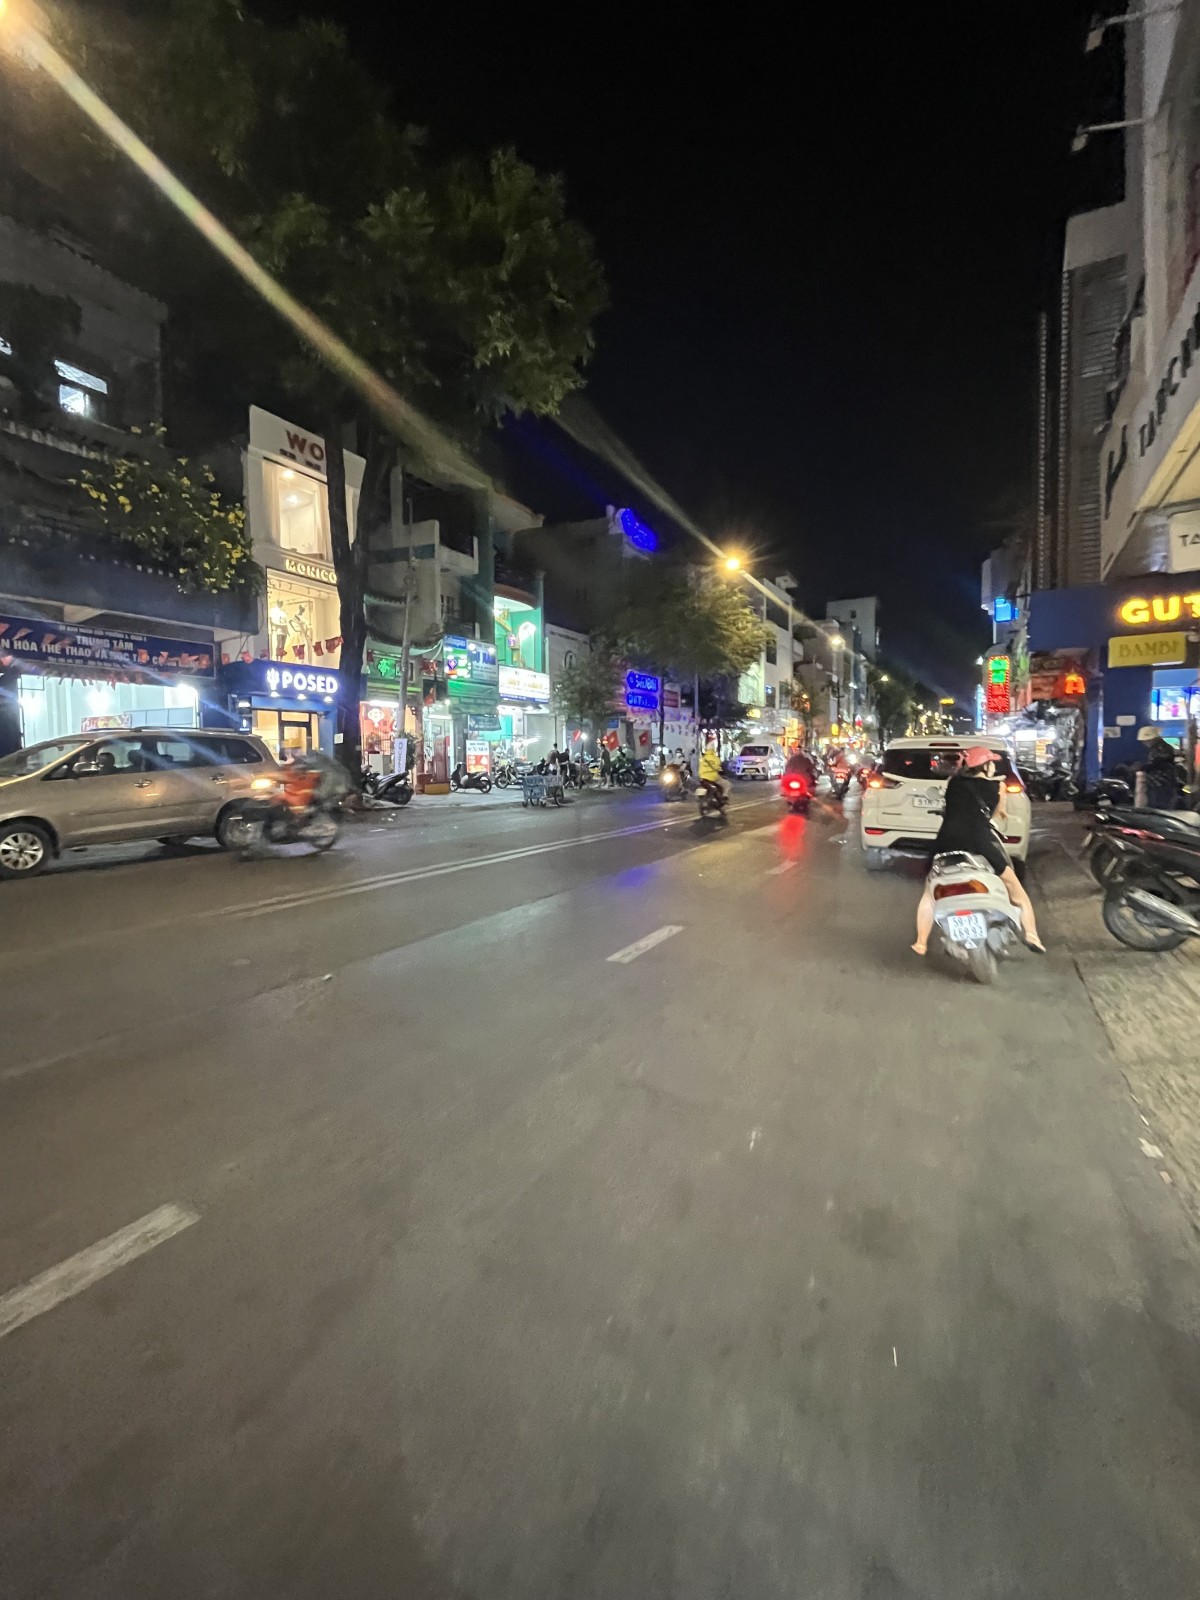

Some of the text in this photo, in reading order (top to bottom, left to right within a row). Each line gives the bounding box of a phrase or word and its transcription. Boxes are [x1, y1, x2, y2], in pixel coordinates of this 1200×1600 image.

[13, 639, 38, 651] HÓA
[65, 646, 91, 657] THAO
[76, 635, 110, 648] TRUNG
[281, 670, 338, 694] POSED
